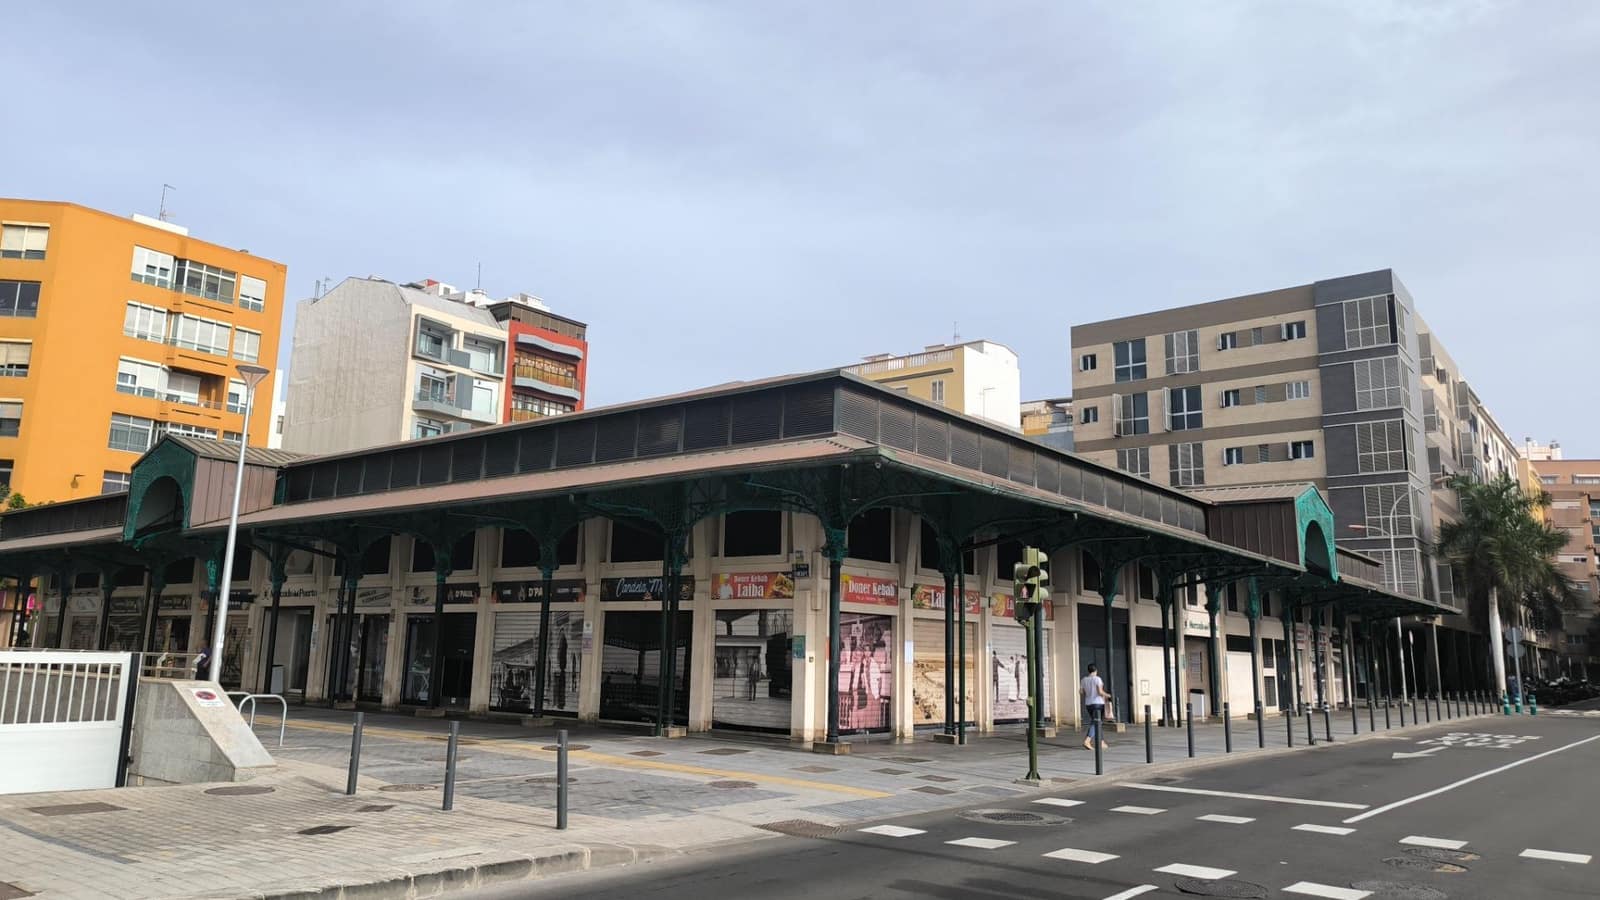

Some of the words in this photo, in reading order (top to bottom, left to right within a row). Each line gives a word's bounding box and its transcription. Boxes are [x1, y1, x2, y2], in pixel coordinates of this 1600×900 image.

[737, 583, 764, 598] Laiba
[848, 580, 871, 595] Doner
[872, 582, 895, 598] Kebab
